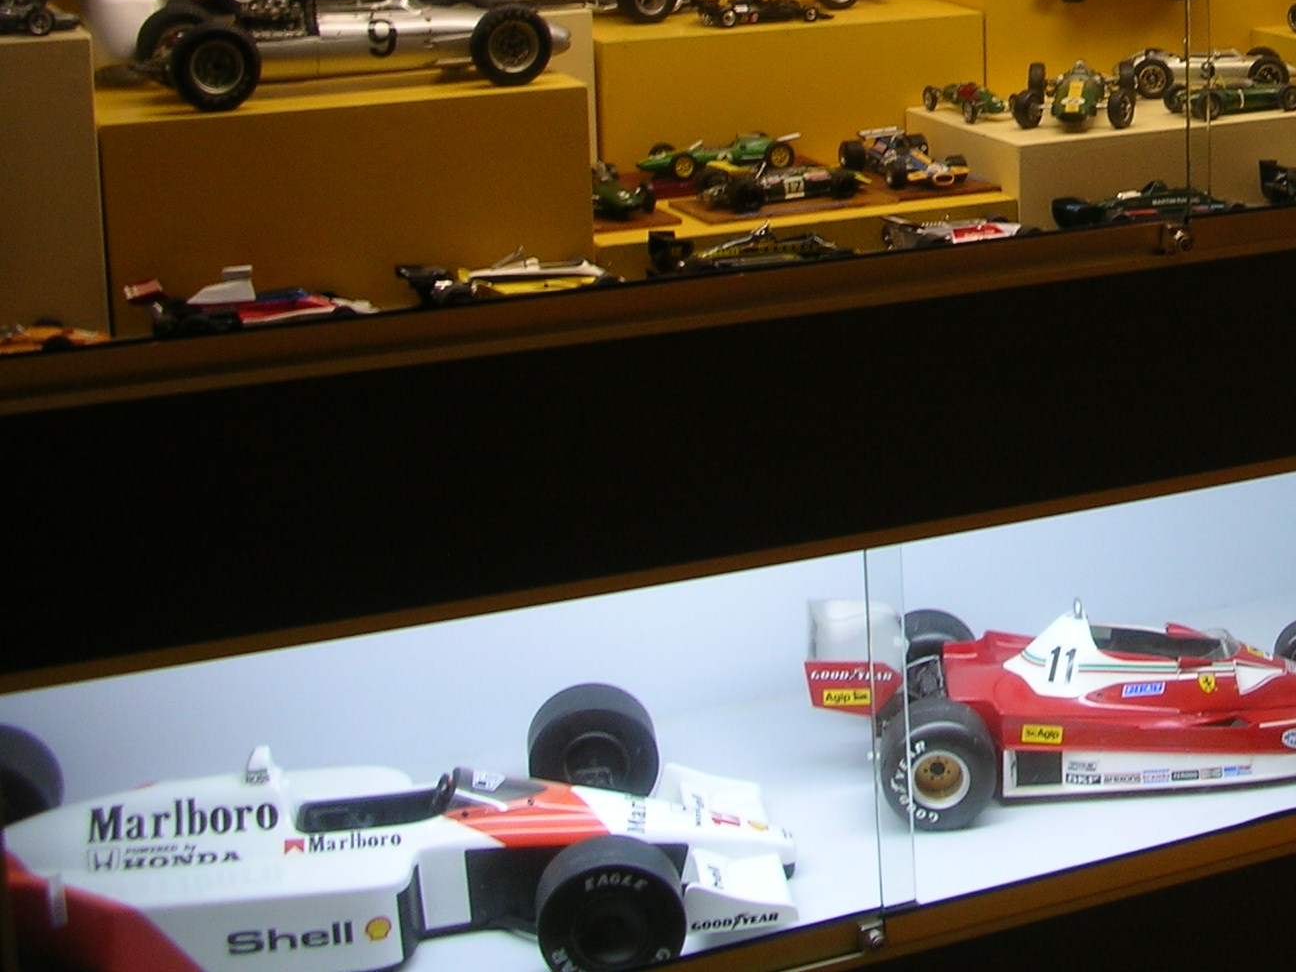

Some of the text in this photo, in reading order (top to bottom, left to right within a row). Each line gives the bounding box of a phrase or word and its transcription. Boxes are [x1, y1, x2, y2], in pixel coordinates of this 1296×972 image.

[368, 19, 397, 58] 9
[1047, 645, 1078, 685] 11
[825, 692, 851, 704] Agip
[1036, 728, 1060, 741] Agip
[87, 797, 279, 844] Marlboro
[307, 832, 402, 854] Marlboro
[122, 850, 243, 870] HONDA
[584, 871, 650, 893] EAGLE
[226, 920, 354, 956] Shell
